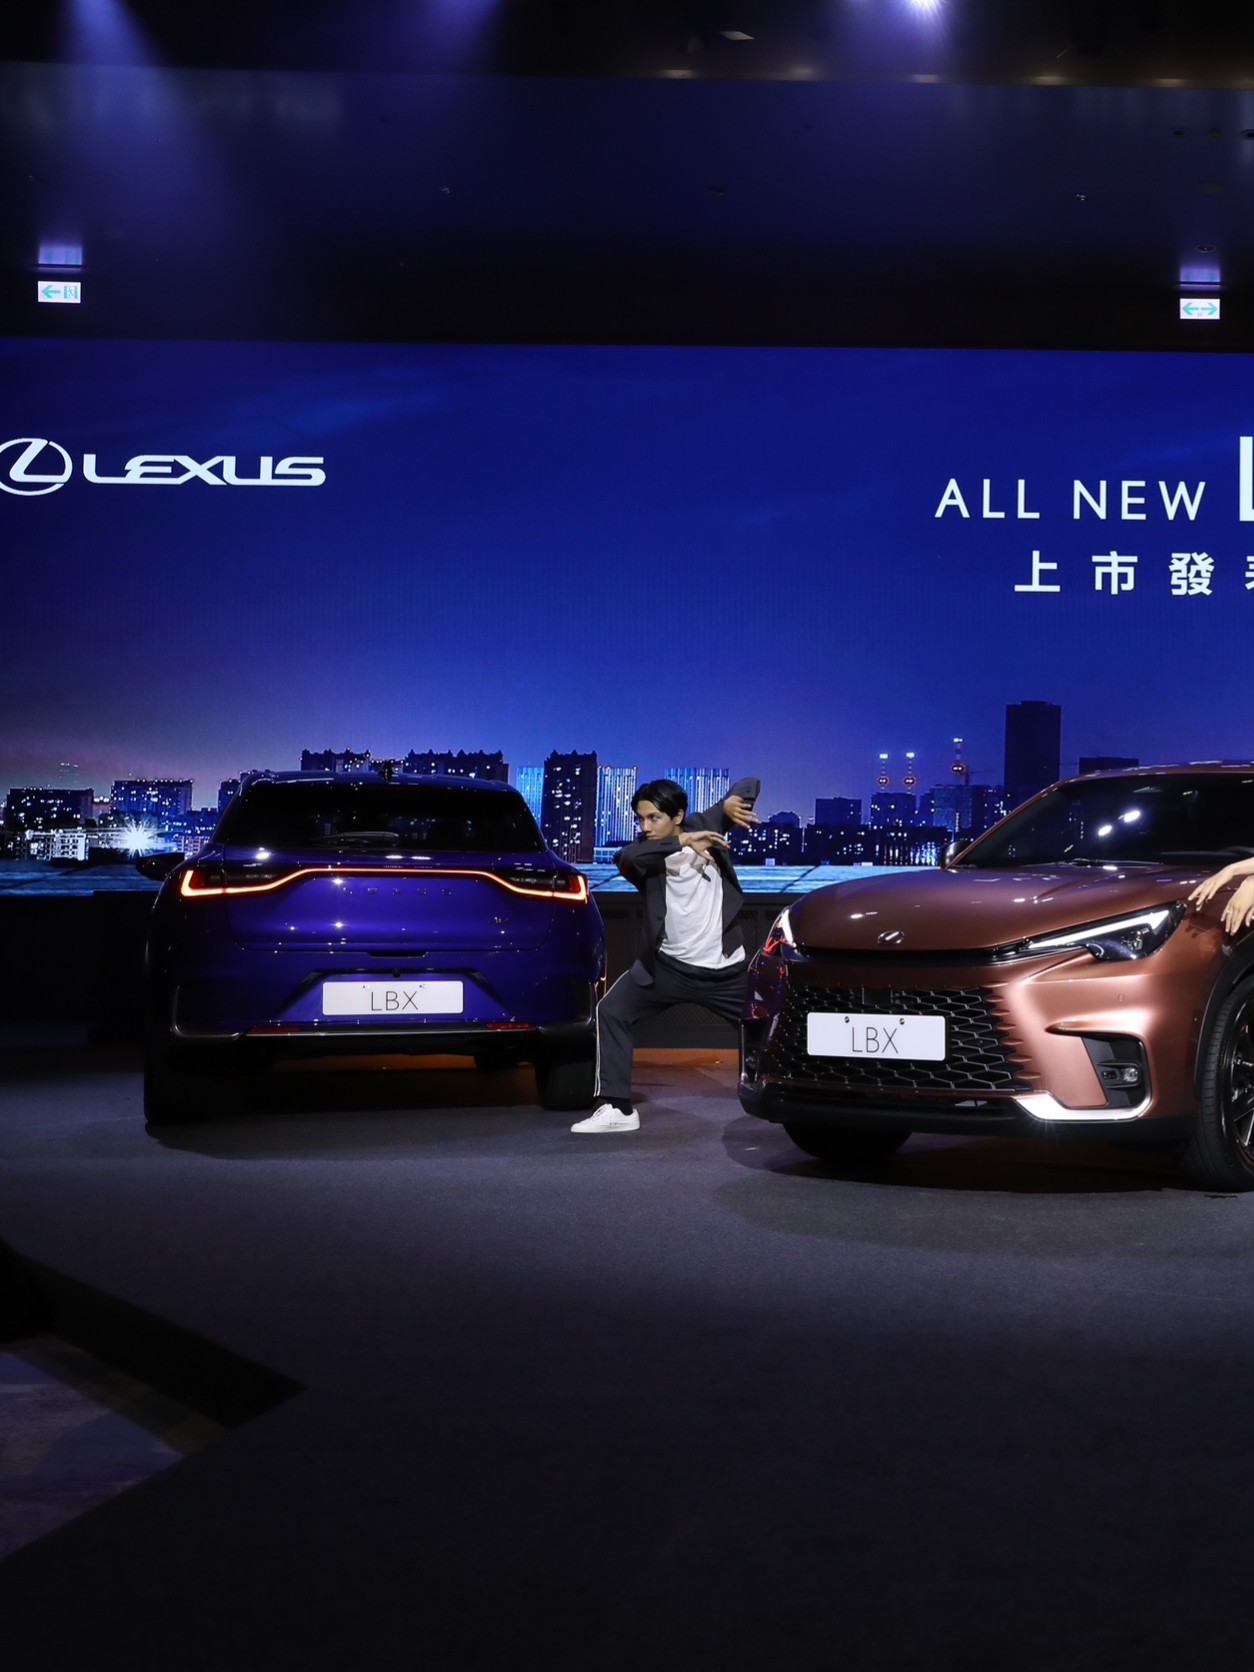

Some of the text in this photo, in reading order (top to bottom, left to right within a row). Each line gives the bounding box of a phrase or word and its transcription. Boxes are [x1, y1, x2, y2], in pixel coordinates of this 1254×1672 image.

[82, 453, 327, 487] LEXUS
[934, 478, 1040, 519] ALL
[1073, 479, 1206, 521] NEW
[370, 990, 419, 1012] LBX
[851, 1026, 899, 1054] LBX
